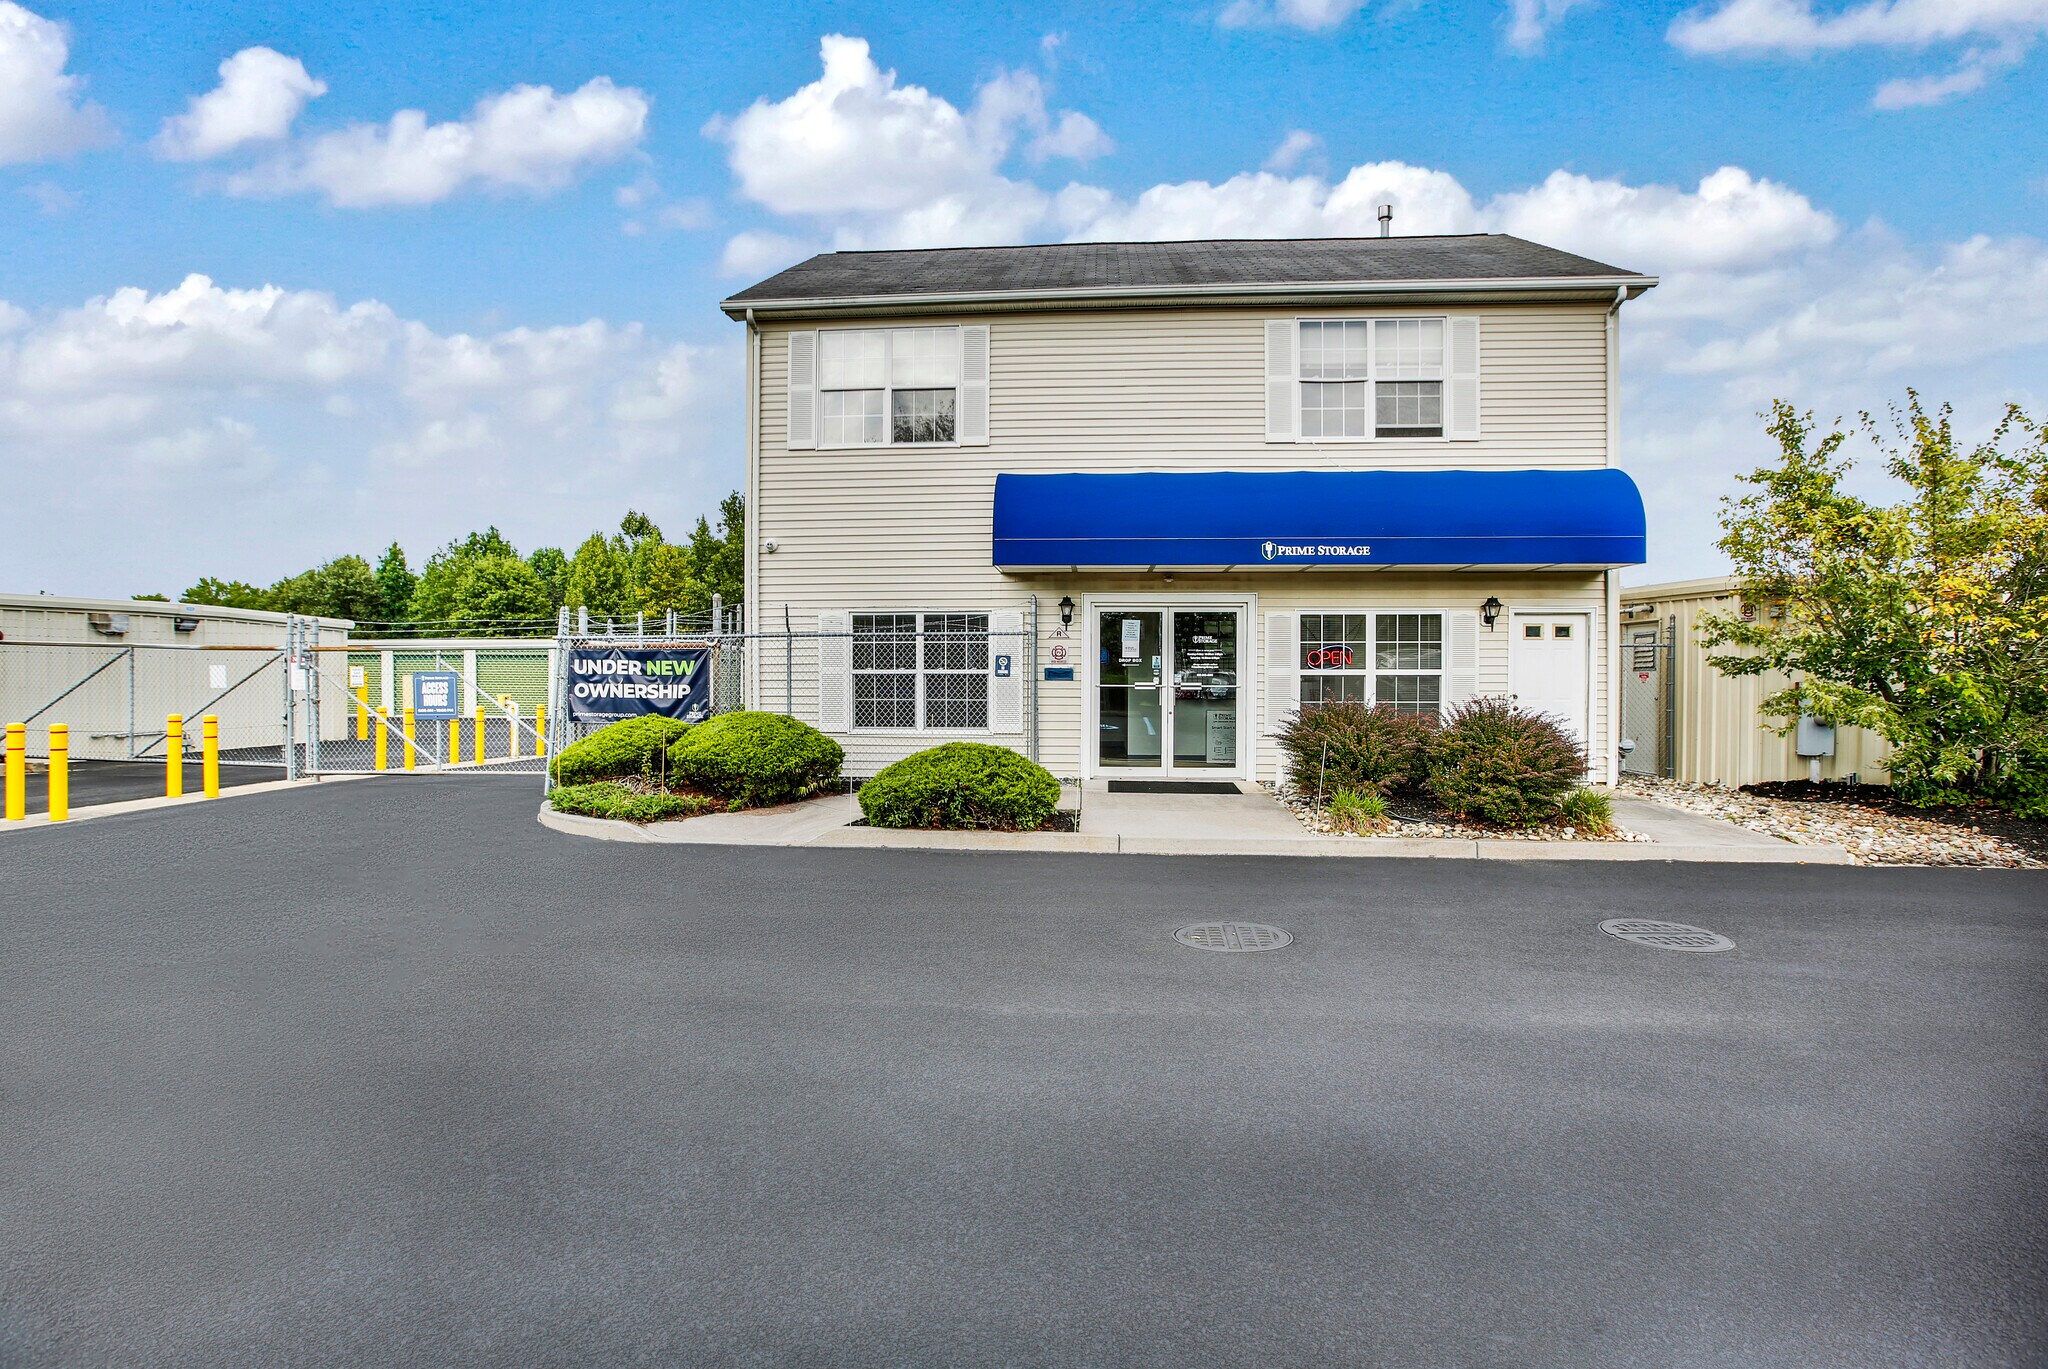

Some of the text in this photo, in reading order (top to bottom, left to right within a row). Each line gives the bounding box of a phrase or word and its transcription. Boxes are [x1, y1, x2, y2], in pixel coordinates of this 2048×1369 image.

[1277, 545, 1371, 556] PRIME STORAGE
[1307, 650, 1353, 666] OPEN
[573, 659, 696, 676] UNDER NEW
[422, 682, 449, 695] ACCESS
[573, 683, 691, 699] OWNERSHIP
[423, 694, 448, 706] HOURS
[572, 711, 638, 719] primestoragegroup.com
